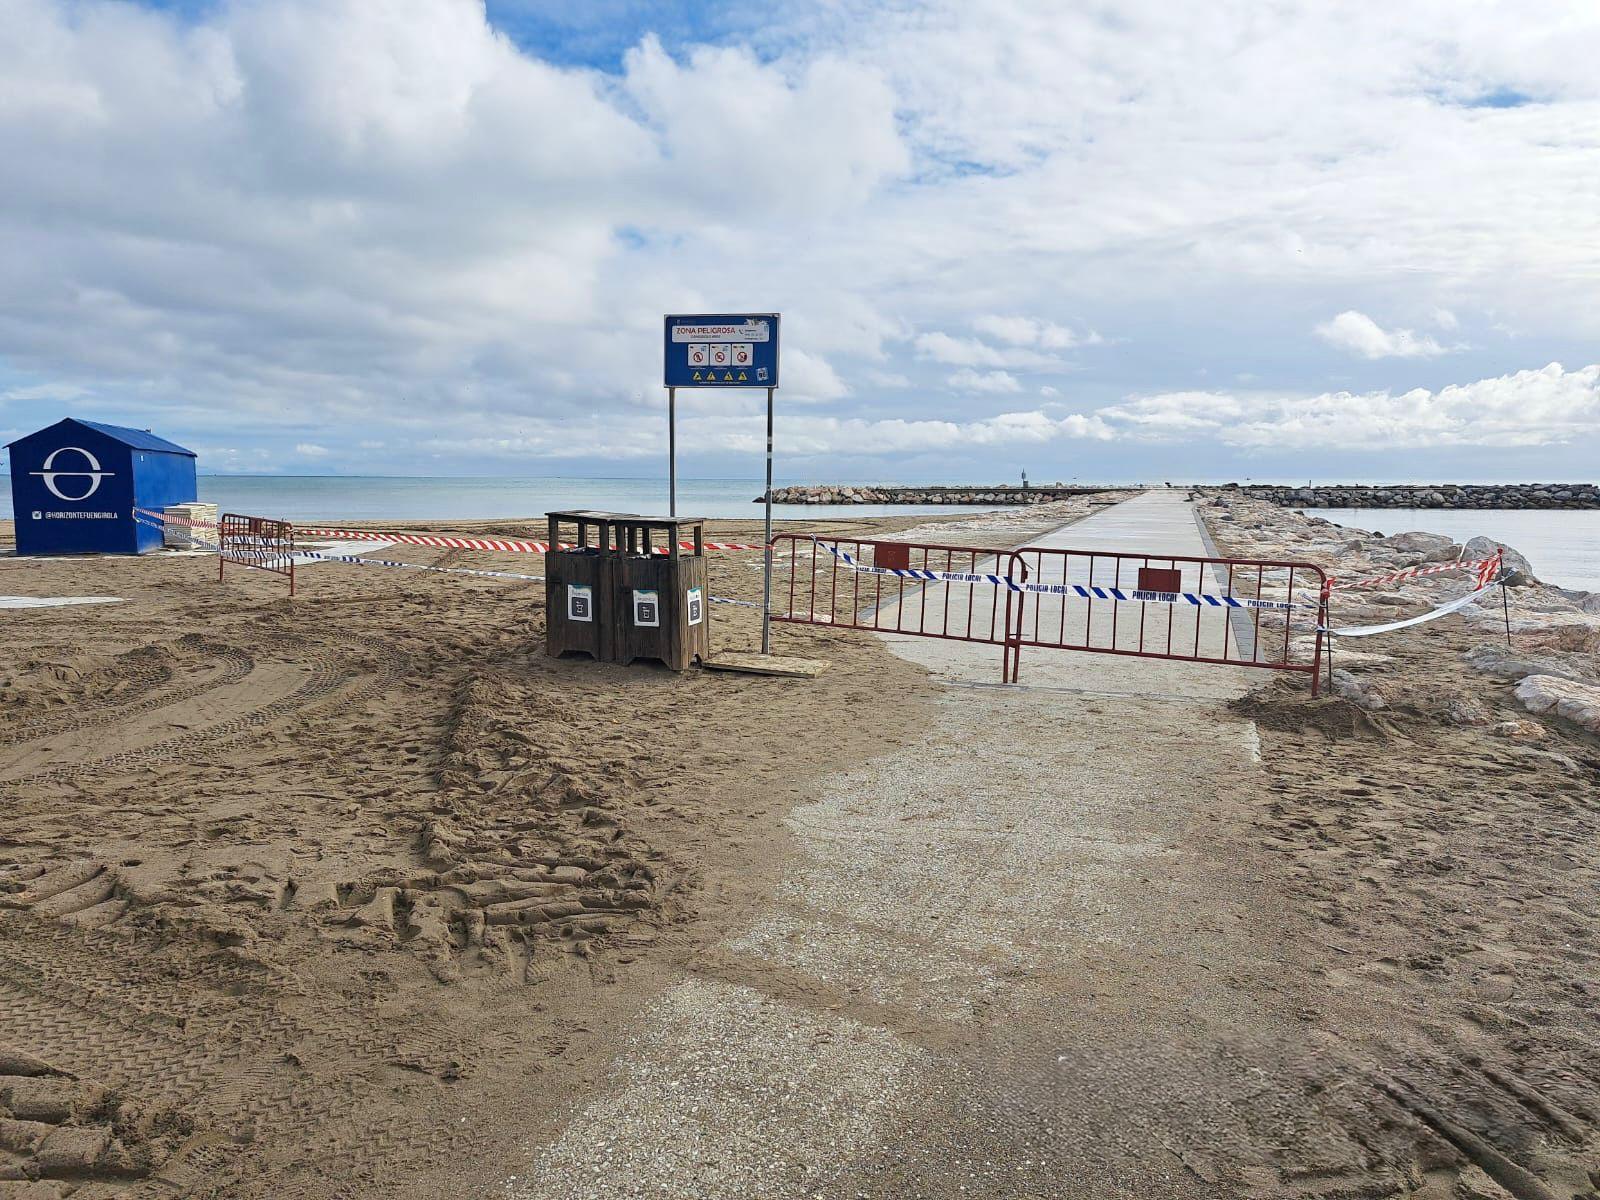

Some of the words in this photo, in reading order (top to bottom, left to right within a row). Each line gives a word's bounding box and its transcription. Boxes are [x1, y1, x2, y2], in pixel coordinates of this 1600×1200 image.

[676, 327, 696, 335] ZONA
[697, 327, 736, 335] PELIGROSA
[45, 511, 118, 520] @HORIZONTEFUENGIROLA
[942, 572, 964, 581] POLICIA
[965, 574, 982, 582] LOCAL
[1025, 584, 1049, 592] POLICIA
[1050, 585, 1068, 594] LOCAL
[1132, 590, 1157, 601] POLICIA
[1158, 592, 1177, 602] LOCAL
[1247, 599, 1274, 608] POLICIA
